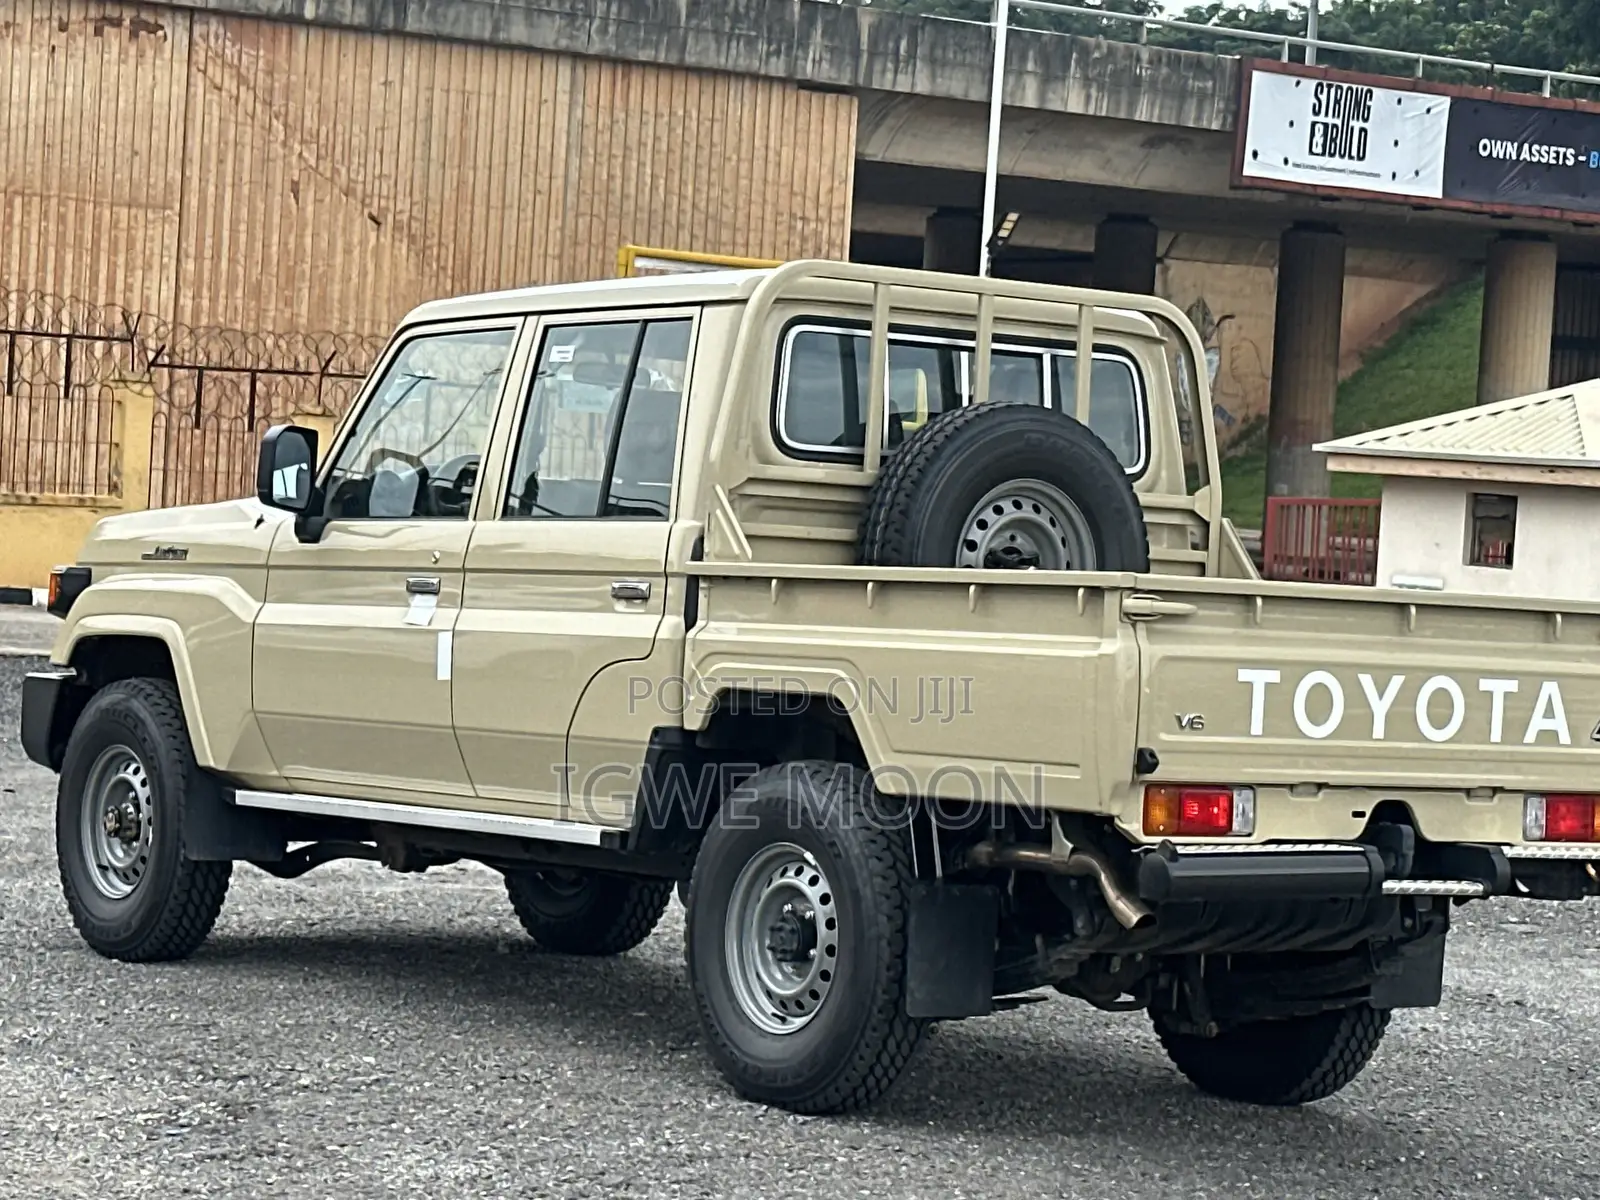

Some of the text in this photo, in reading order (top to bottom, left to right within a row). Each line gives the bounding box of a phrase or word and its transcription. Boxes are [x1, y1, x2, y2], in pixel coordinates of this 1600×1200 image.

[1311, 81, 1374, 123] STRONG
[1478, 138, 1518, 160] OWN
[1519, 142, 1575, 166] ASSETS
[1174, 713, 1205, 731] V6
[1237, 668, 1572, 745] TOYOTA
